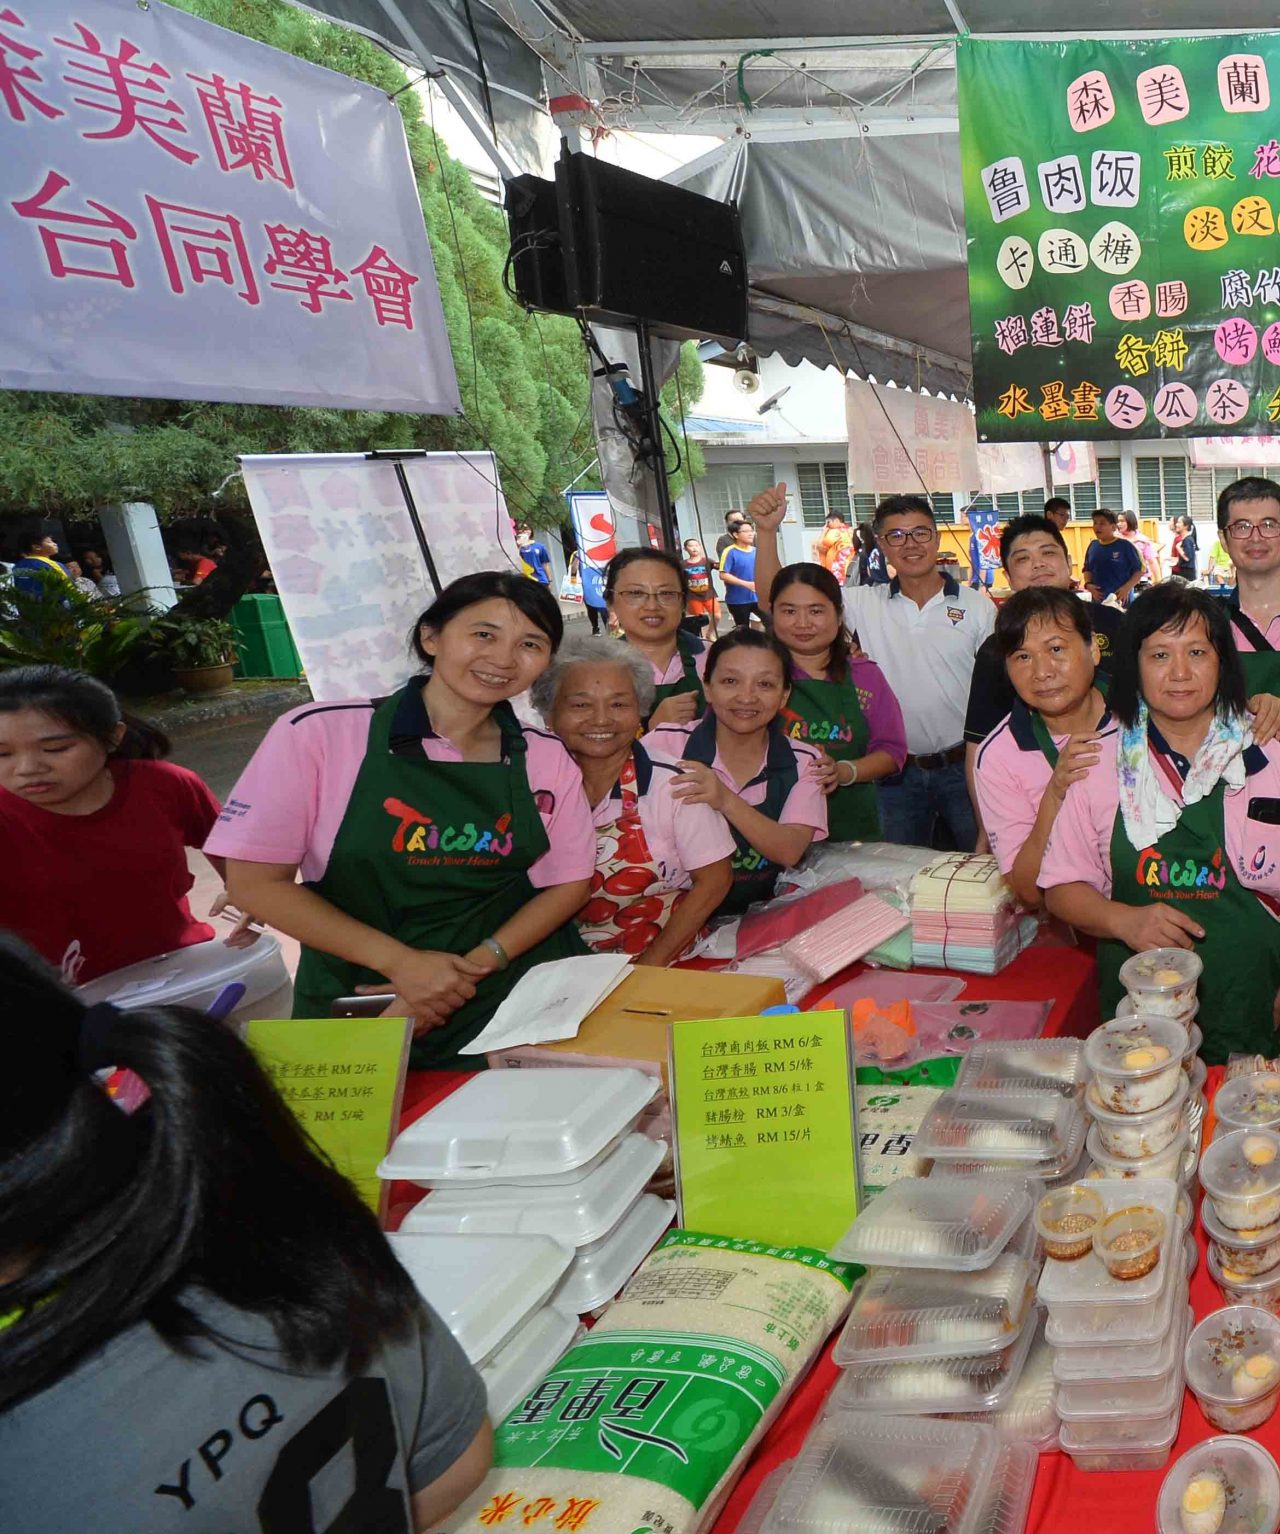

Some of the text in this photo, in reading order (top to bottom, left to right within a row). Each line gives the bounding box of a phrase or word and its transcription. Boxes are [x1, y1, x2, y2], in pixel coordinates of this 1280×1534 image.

[1166, 145, 1235, 181] 煎餃
[12, 171, 419, 330] 台同學會
[1005, 232, 1135, 283] 卡通糖
[1115, 284, 1188, 314] 香腸
[997, 305, 1095, 354] 榴蓮餅
[1116, 330, 1187, 377] 香餅
[998, 381, 1100, 421] 水墨畫
[1108, 384, 1244, 424] 冬瓜茶
[773, 1039, 794, 1050] RM
[798, 1035, 823, 1048] 6/盒
[331, 1064, 351, 1075] RM
[764, 1062, 785, 1073] RM
[281, 1087, 325, 1099] 冬瓜茶
[328, 1087, 347, 1098] RM
[752, 1086, 770, 1095] RM
[773, 1085, 788, 1095] 8/6
[815, 1081, 824, 1093] 盒
[314, 1110, 334, 1121] RM
[756, 1107, 777, 1119] RM
[782, 1103, 806, 1117] 3/盒
[757, 1130, 778, 1143] RM
[783, 1128, 811, 1141] 15/片
[154, 1393, 283, 1511] YPQ
[480, 1491, 603, 1533] 放心米
